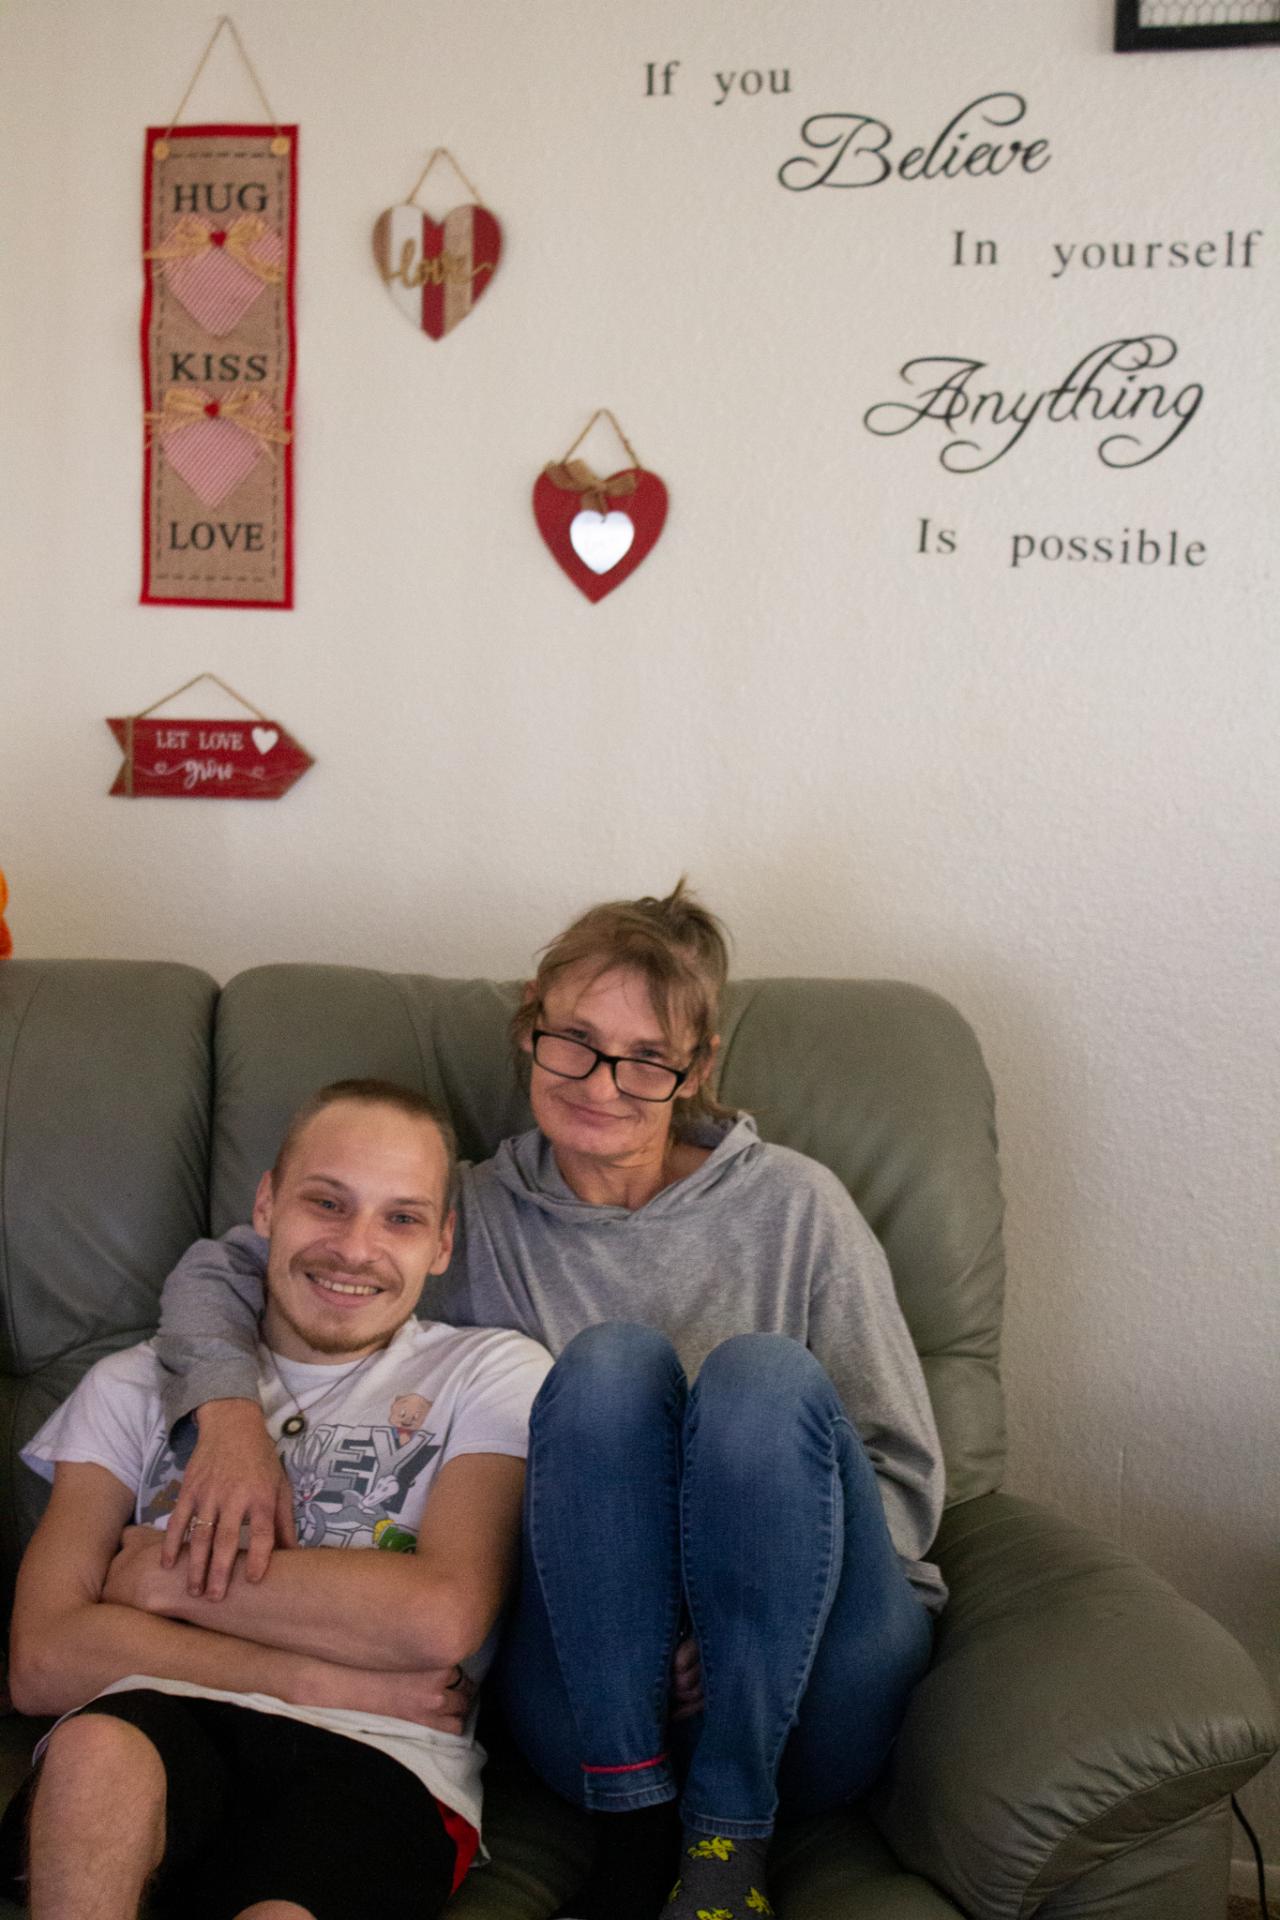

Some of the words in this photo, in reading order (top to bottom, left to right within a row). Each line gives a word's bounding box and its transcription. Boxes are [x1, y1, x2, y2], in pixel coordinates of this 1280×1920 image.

[645, 60, 681, 97] If
[713, 68, 791, 106] you
[778, 91, 1051, 192] Believe
[172, 183, 268, 213] HUG
[952, 230, 998, 267] In
[1051, 230, 1263, 278] yourself
[170, 352, 268, 383] KISS
[863, 334, 1204, 474] Anything
[169, 521, 264, 553] LOVE
[917, 518, 958, 555] Is
[1010, 527, 1207, 568] possible
[156, 730, 189, 750] LET
[199, 731, 244, 752] LOVE
